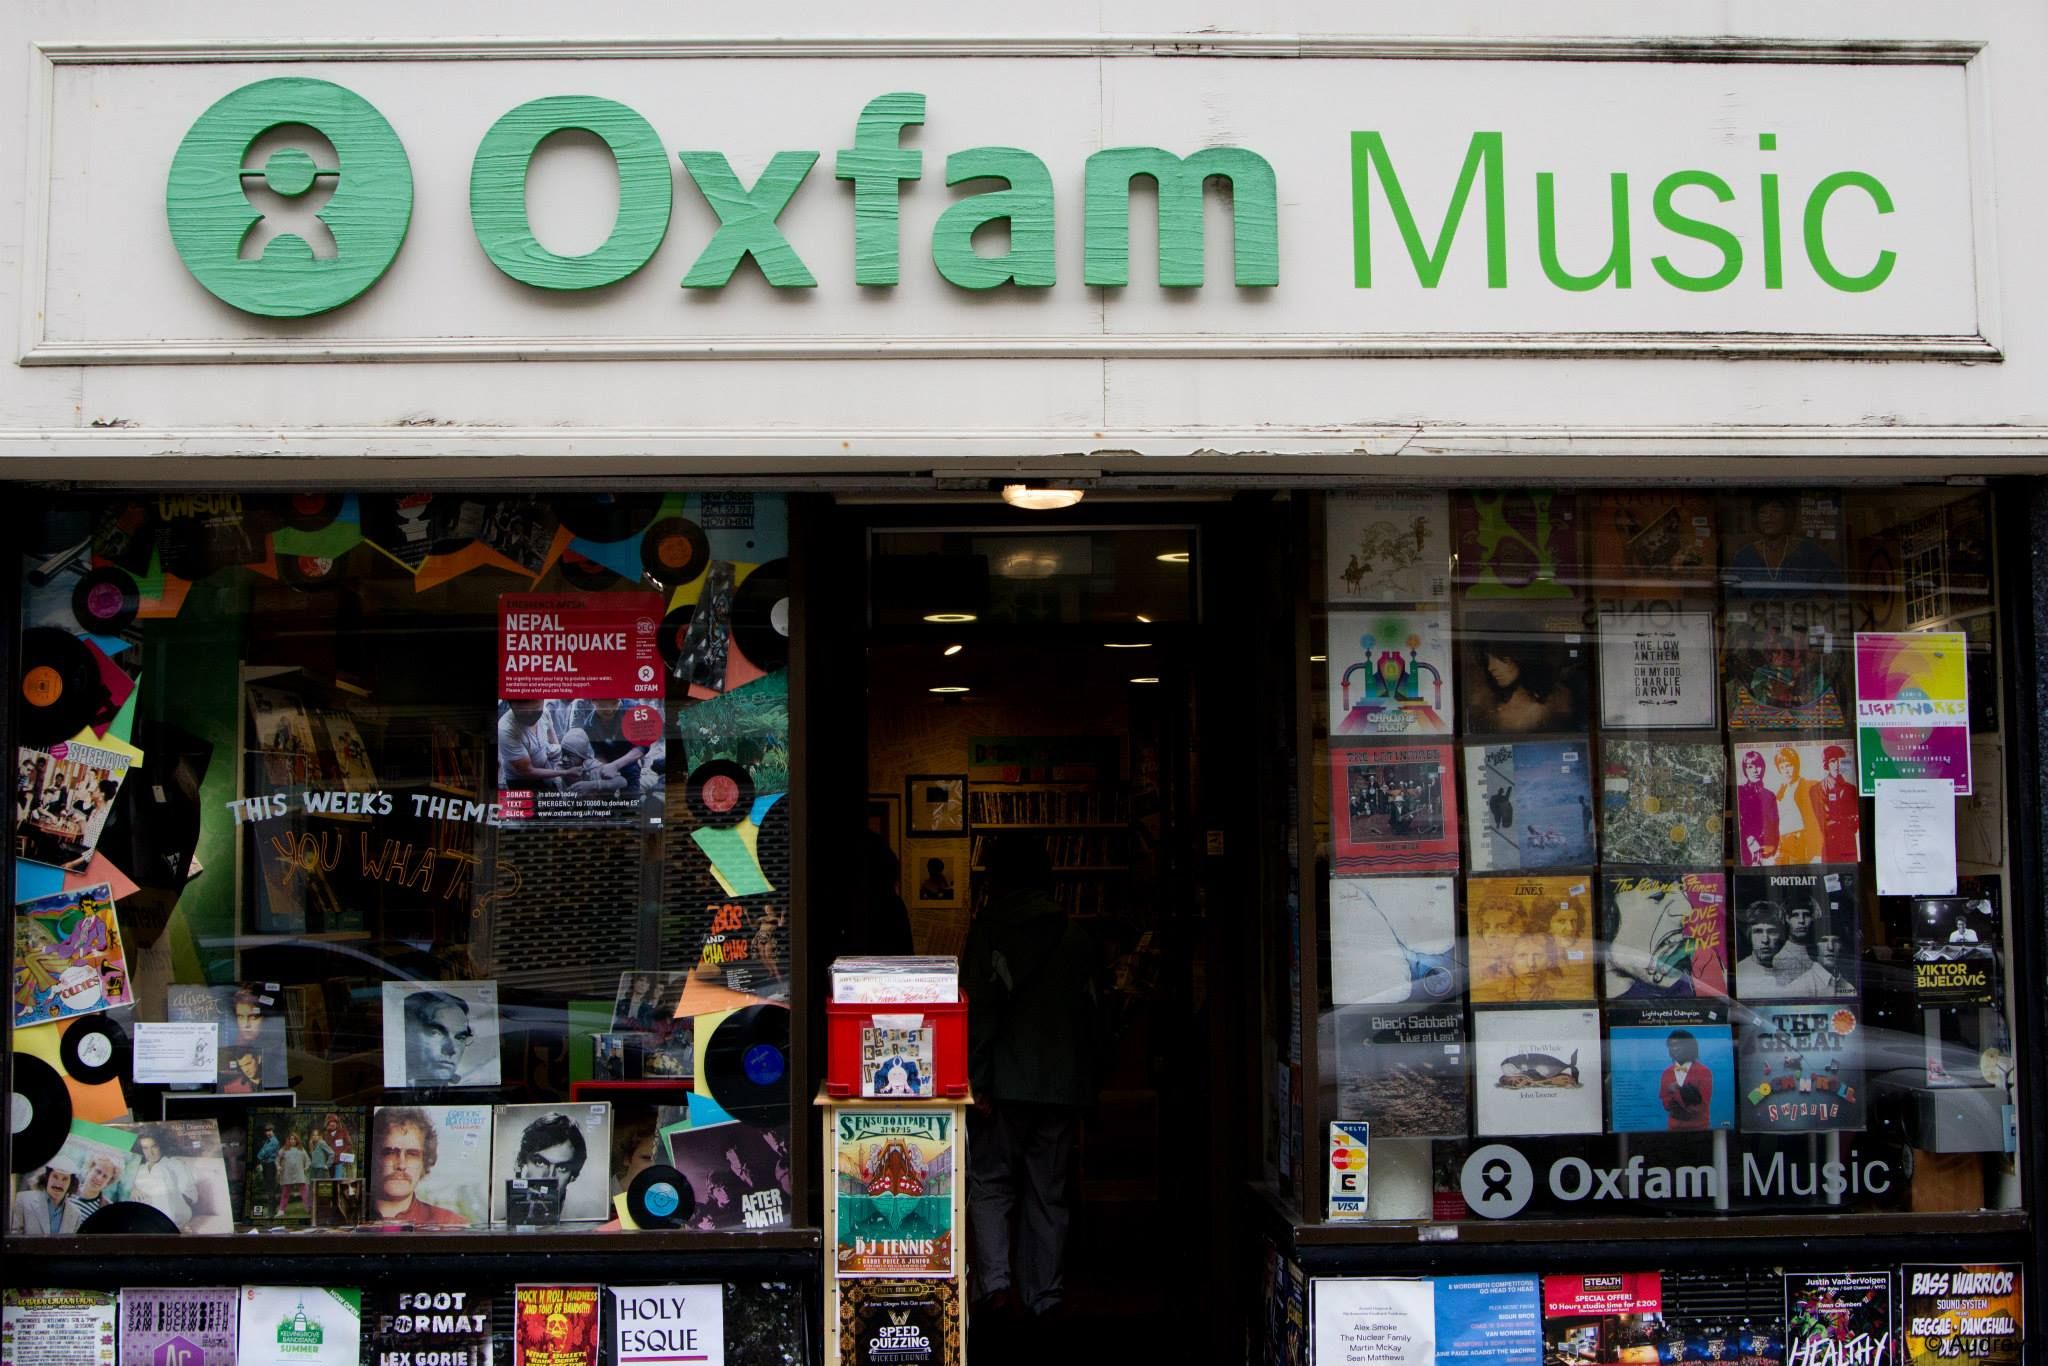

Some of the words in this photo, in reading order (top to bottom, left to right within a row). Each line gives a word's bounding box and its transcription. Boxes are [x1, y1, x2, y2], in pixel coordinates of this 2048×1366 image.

[468, 92, 1279, 290] Oxfam
[1350, 131, 1897, 292] Music
[506, 613, 565, 631] NEPAL
[506, 633, 627, 653] EARTHQUAKE
[1633, 641, 1653, 650] THE
[1657, 641, 1679, 650] LOW
[1634, 651, 1680, 661] ANTHEM
[505, 654, 578, 672] APPEAL
[1648, 667, 1660, 676] MY
[634, 683, 659, 692] OXFAM
[1635, 677, 1680, 687] CHARLIE
[1636, 687, 1681, 697] DARWIN
[634, 708, 649, 721] £5
[69, 742, 132, 772] SPECIALS
[226, 792, 288, 825] THIS
[303, 789, 393, 815] WEEK'S
[411, 794, 504, 829] THEME
[506, 809, 525, 817] CLICK
[271, 831, 343, 886] YOU
[1770, 876, 1817, 886] PORTRAIT
[1515, 886, 1545, 896] LINES
[1681, 903, 1719, 925] LOVE
[1690, 919, 1717, 938] YOU
[703, 934, 726, 944] AND
[1684, 931, 1720, 953] LIVE
[1916, 963, 1967, 976] VIKTOR
[1917, 970, 1986, 988] BIJELOVIĆ
[1371, 1016, 1407, 1030] Black
[1408, 1015, 1458, 1029] Sabbath
[1771, 1013, 1829, 1032] THE
[1758, 1031, 1845, 1052] GREAT
[1768, 1103, 1839, 1121] SWINDLE
[1549, 1156, 1719, 1201] Oxfam
[1742, 1150, 1891, 1198] Music
[741, 1187, 780, 1210] AFTER
[1338, 1202, 1359, 1211] VISA
[855, 1239, 877, 1255] DJ
[883, 1239, 934, 1255] TENNIS
[1584, 1277, 1621, 1286] STEALTH
[1805, 1278, 1830, 1286] Justin
[1831, 1277, 1887, 1286] VanDerVolgen
[1911, 1272, 1950, 1295] BASS
[1951, 1271, 2015, 1295] WARRIOR
[400, 1292, 467, 1311] FOOT
[518, 1290, 539, 1302] ROCK
[547, 1290, 564, 1302] ROLL
[565, 1290, 598, 1302] MADNESS
[1575, 1294, 1604, 1302] SPECIAL
[524, 1303, 539, 1314] AND
[554, 1303, 563, 1314] OF
[620, 1298, 686, 1320] HOLY
[1606, 1301, 1622, 1309] time
[1937, 1300, 1960, 1310] SOUND
[1961, 1299, 1988, 1309] SYSTEM
[381, 1315, 487, 1334] FORMAT
[1911, 1317, 1952, 1336] REGGAE
[1960, 1317, 2015, 1335] DANCEHALL
[879, 1326, 920, 1337] SPEED
[1387, 1333, 1412, 1343] Family
[621, 1329, 699, 1351] ESQUE
[870, 1337, 930, 1349] QUIZZING
[280, 1345, 319, 1353] SUMMER
[526, 1350, 551, 1359] NINE
[1376, 1344, 1402, 1352] McKay
[1789, 1332, 1889, 1366] HEALTHY
[381, 1351, 410, 1366] LEX
[415, 1351, 468, 1366] GORIE
[869, 1354, 899, 1362] WICKED
